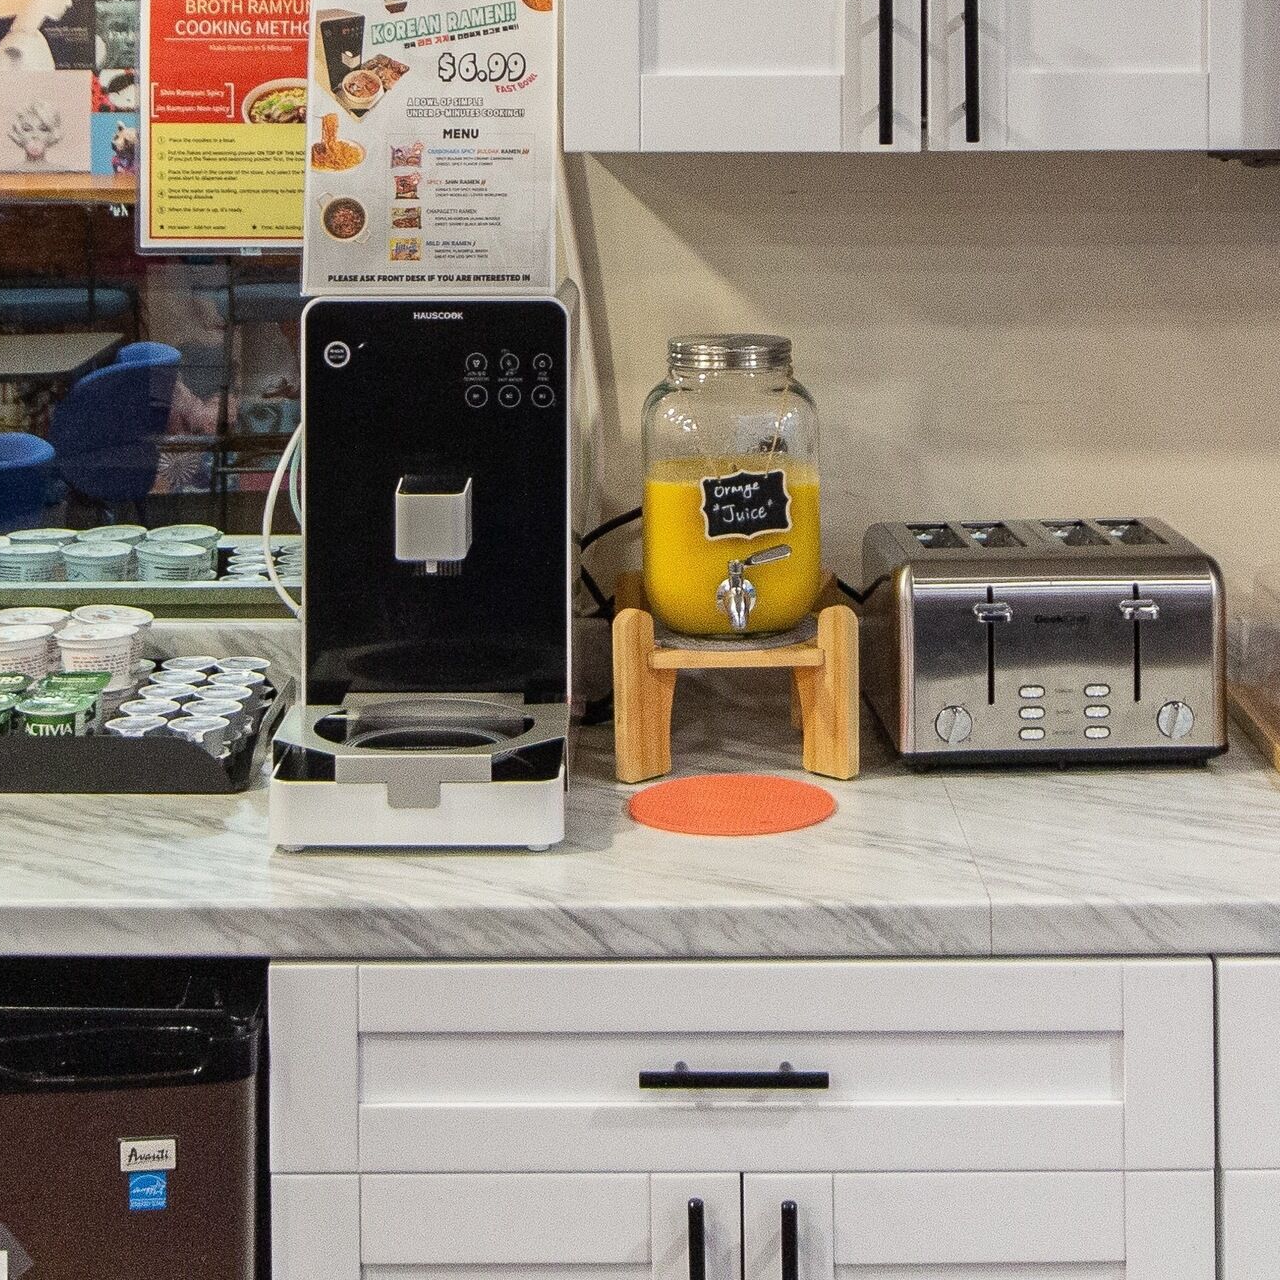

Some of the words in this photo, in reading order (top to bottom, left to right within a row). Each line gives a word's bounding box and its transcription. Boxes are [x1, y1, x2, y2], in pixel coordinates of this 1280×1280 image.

[185, 0, 243, 14] BROTH
[175, 20, 251, 35] COOKING
[371, 14, 441, 45] KOREAN
[446, 1, 517, 33] RAMEN!!
[437, 52, 527, 83] $6.99
[495, 82, 518, 94] FAST
[518, 72, 538, 89] BOWL
[407, 97, 414, 106] A
[414, 97, 439, 106] BOWL
[440, 97, 452, 106] OF
[452, 97, 484, 106] SIMPLE
[406, 108, 434, 118] UNDER
[443, 128, 480, 139] MENU
[328, 274, 358, 282] PLEASE
[359, 274, 375, 282] ASK
[377, 274, 405, 282] FRONT
[406, 274, 426, 282] DESK
[427, 274, 435, 282] IF
[437, 274, 454, 282] YOU
[455, 274, 471, 282] ARE
[473, 274, 521, 282] INTERESTED
[522, 274, 530, 282] IN
[413, 312, 464, 320] HAUSCOOK
[25, 723, 73, 736] ACTIVIA
